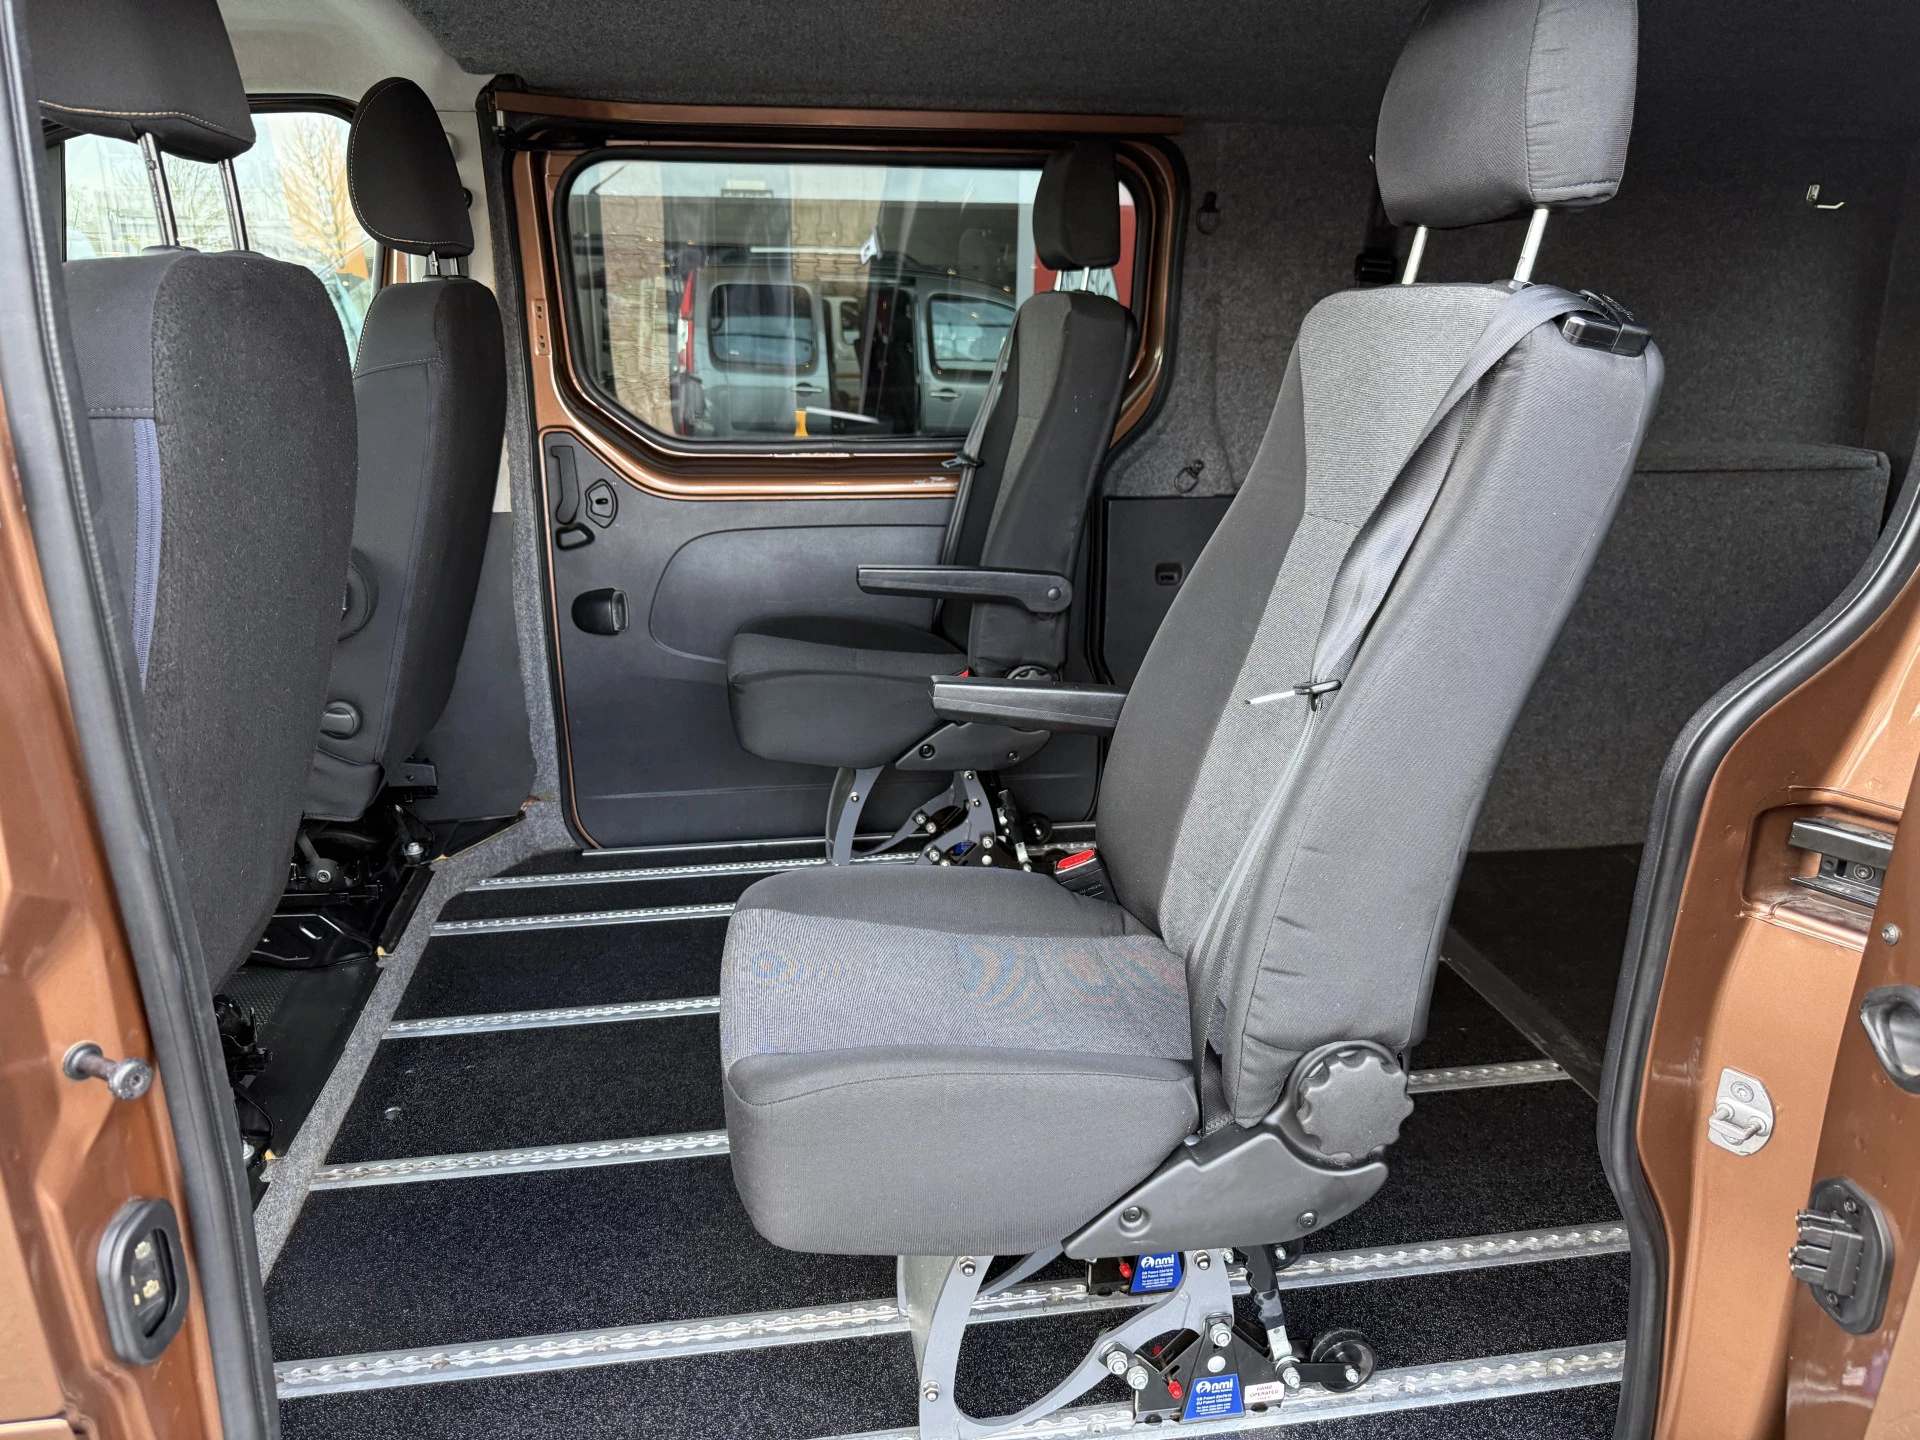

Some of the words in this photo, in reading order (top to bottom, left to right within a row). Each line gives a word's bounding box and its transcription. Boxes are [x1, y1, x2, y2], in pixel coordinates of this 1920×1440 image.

[1155, 1254, 1174, 1265] nmi
[1211, 1378, 1234, 1391] nmi
[1249, 1389, 1279, 1397] OPERATED
